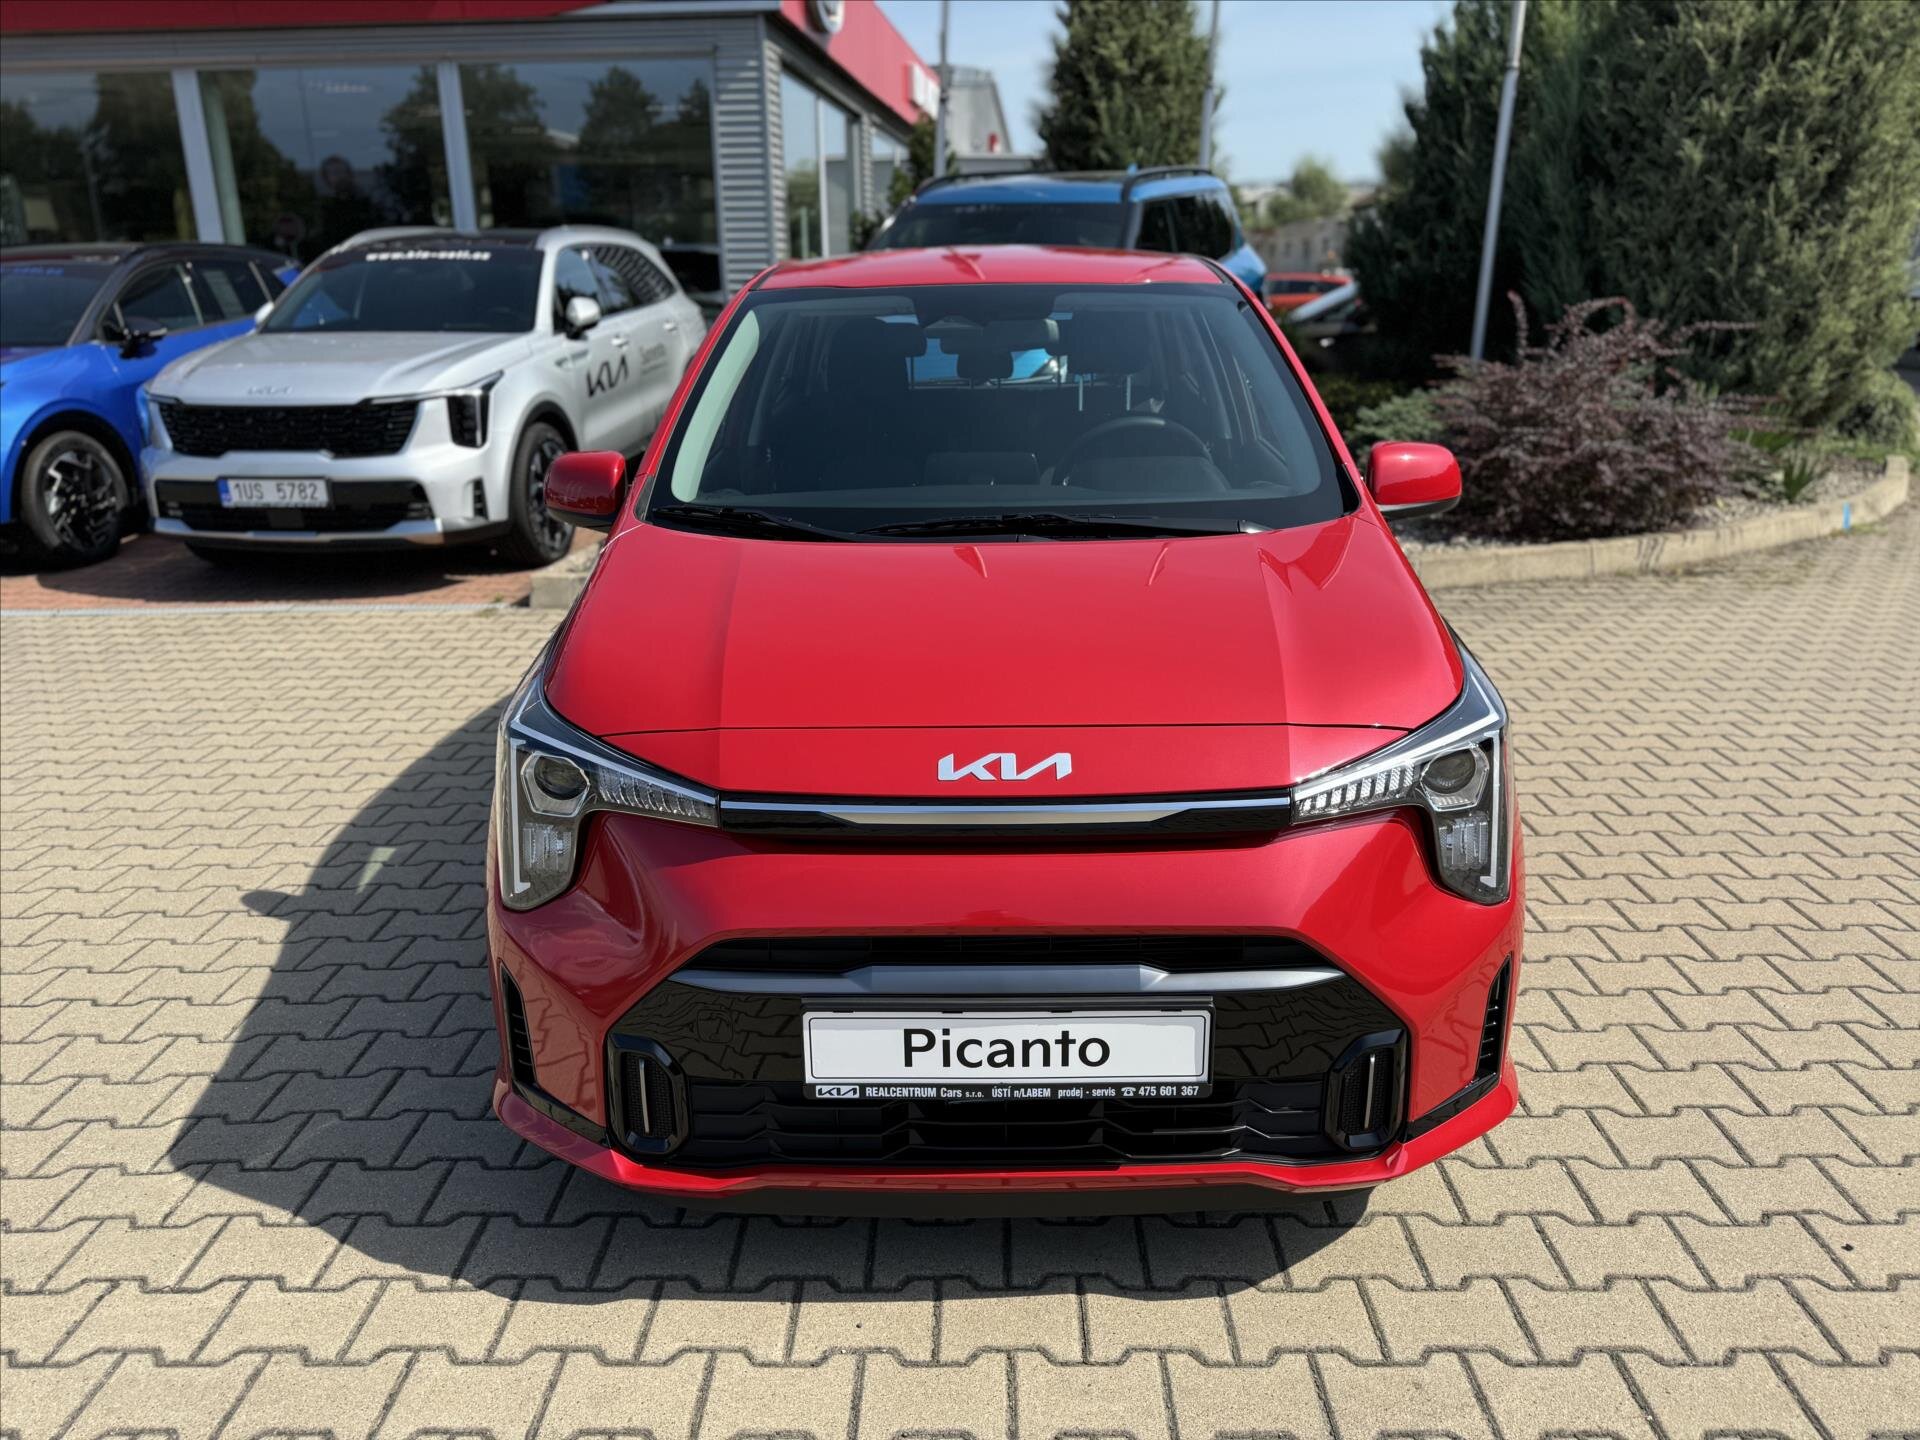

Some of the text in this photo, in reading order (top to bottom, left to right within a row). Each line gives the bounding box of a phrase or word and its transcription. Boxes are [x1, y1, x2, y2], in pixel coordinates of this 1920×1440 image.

[586, 355, 629, 398] KIA
[234, 482, 264, 500] 1US
[275, 482, 318, 501] 5782
[937, 752, 1072, 780] KIA
[902, 1028, 1111, 1068] Picanto
[817, 1087, 857, 1096] KIA
[865, 1087, 937, 1098] REALCENTRUM
[940, 1087, 963, 1098] Cars
[965, 1089, 985, 1098] s.r.o.
[991, 1085, 1011, 1097] ÚSTÍ
[1013, 1087, 1051, 1097] n/LABEM
[1058, 1087, 1083, 1098] prodej
[1092, 1087, 1116, 1097] servis
[1139, 1086, 1157, 1096] 475
[1160, 1086, 1177, 1096] 601
[1181, 1086, 1199, 1096] 367
